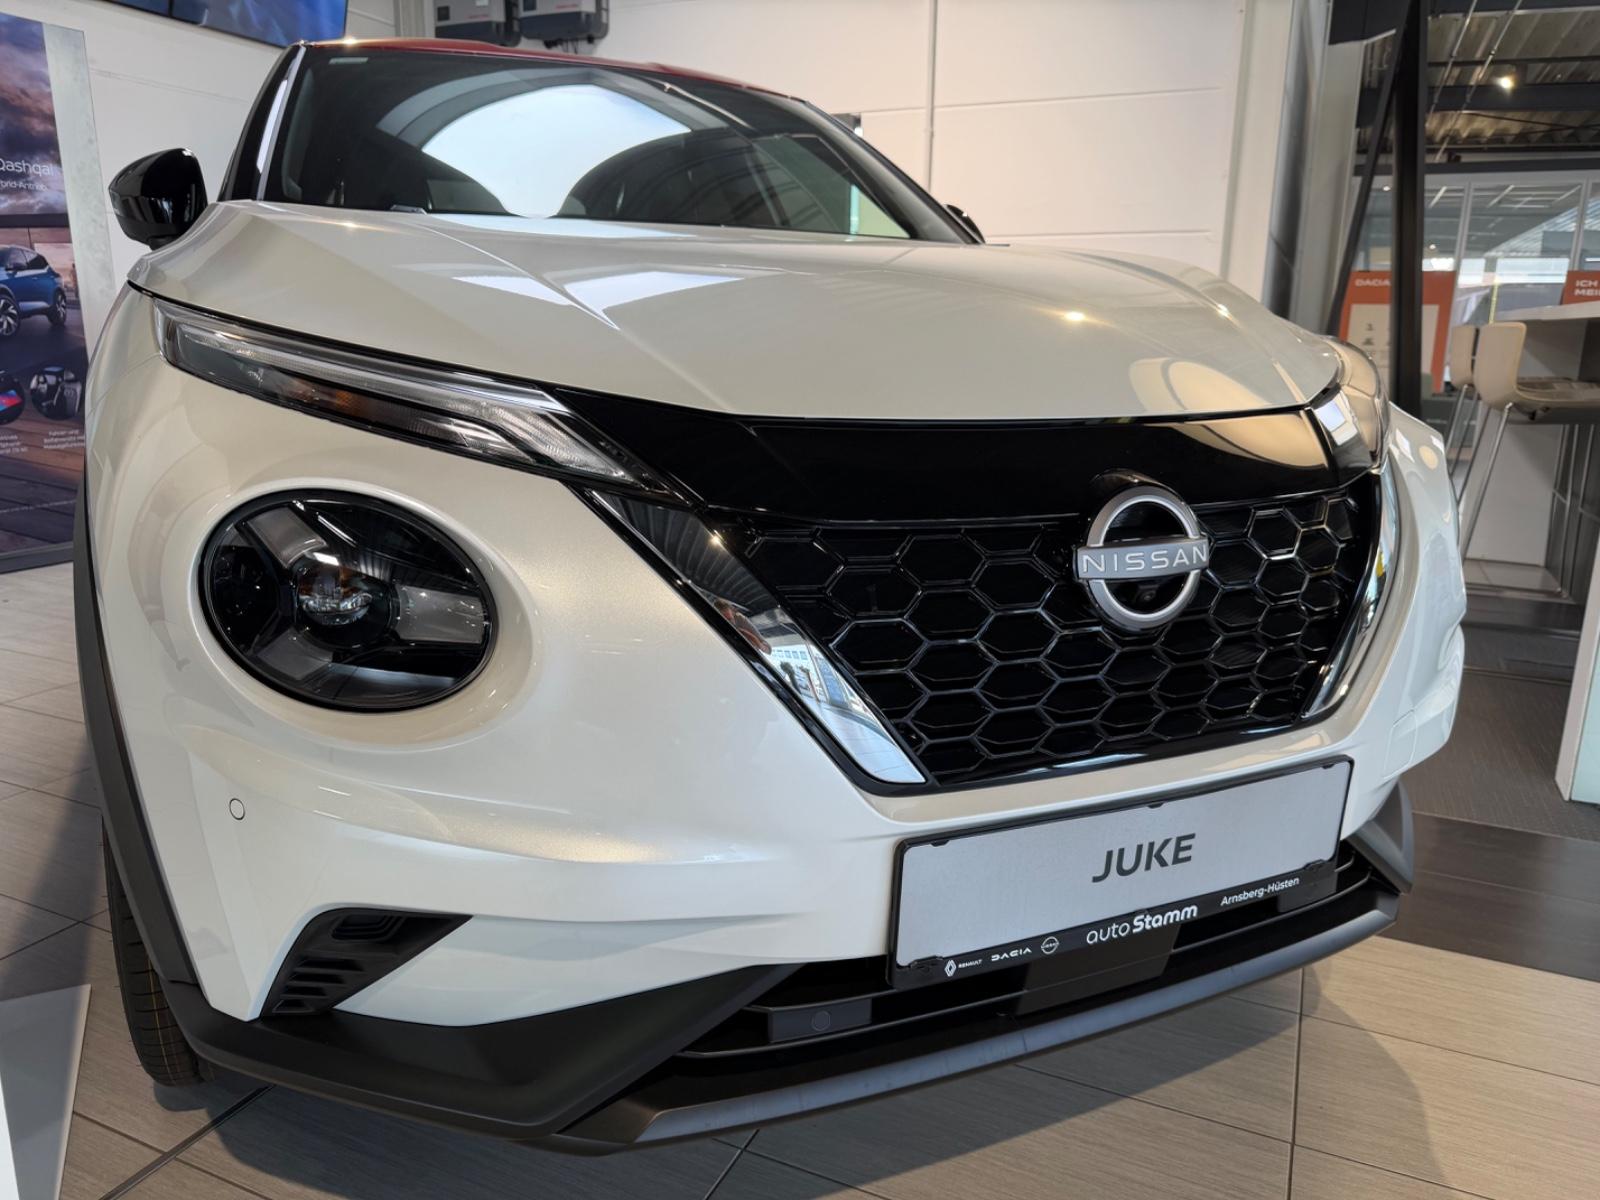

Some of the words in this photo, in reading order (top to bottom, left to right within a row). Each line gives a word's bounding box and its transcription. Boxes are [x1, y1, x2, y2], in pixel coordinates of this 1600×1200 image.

[1355, 278, 1391, 287] DACIA
[1574, 288, 1600, 296] MEI
[1575, 279, 1599, 288] ICH
[1082, 544, 1207, 573] NISSAN
[1092, 833, 1196, 883] JUKE
[991, 947, 1032, 962] DACIA
[1220, 876, 1300, 906] Arnsberg-Hüsten
